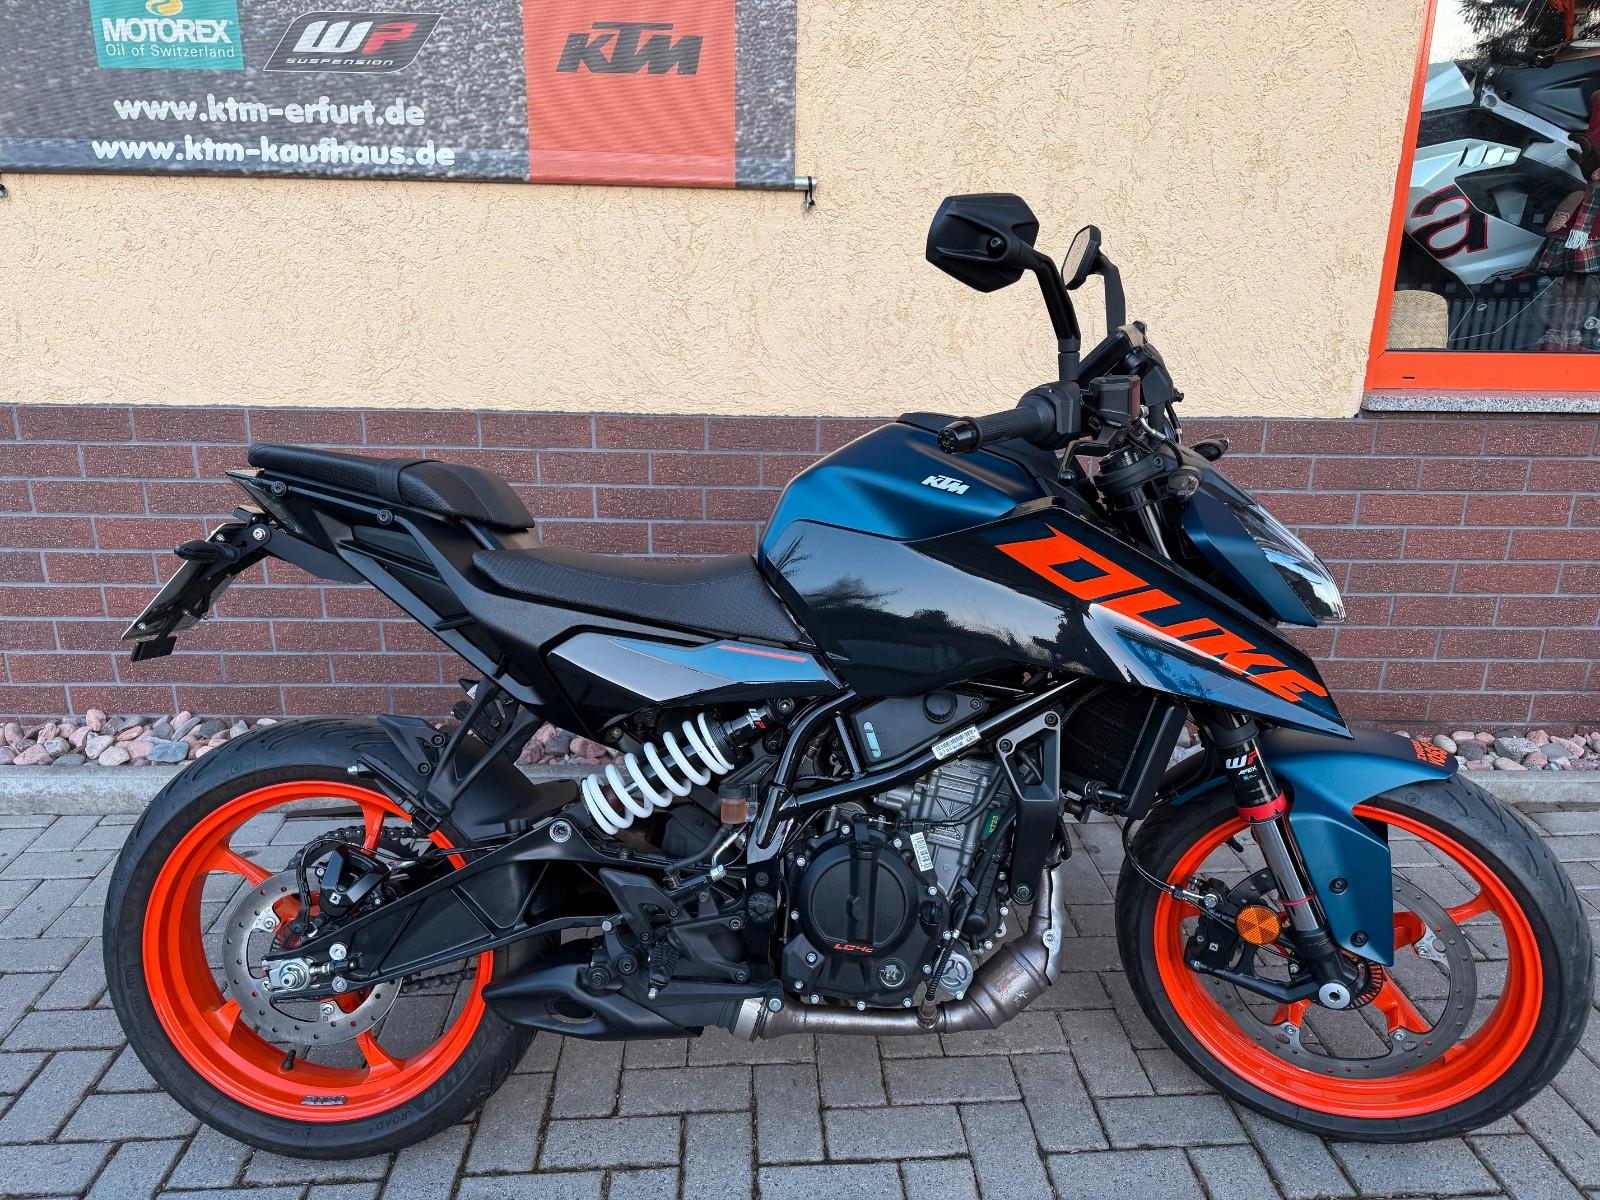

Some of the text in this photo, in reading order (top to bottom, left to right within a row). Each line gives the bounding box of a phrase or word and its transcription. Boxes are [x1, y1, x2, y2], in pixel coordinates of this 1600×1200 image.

[101, 17, 232, 44] MOTOREX
[292, 20, 418, 55] WP
[105, 44, 235, 58] Oil of Switzerland
[555, 21, 704, 76] KTM
[113, 93, 426, 126] www.ktm-erfurt.de
[91, 134, 456, 166] www.ktm-kaufhaus.de
[921, 474, 971, 495] KTM
[995, 521, 1328, 703] DUKE
